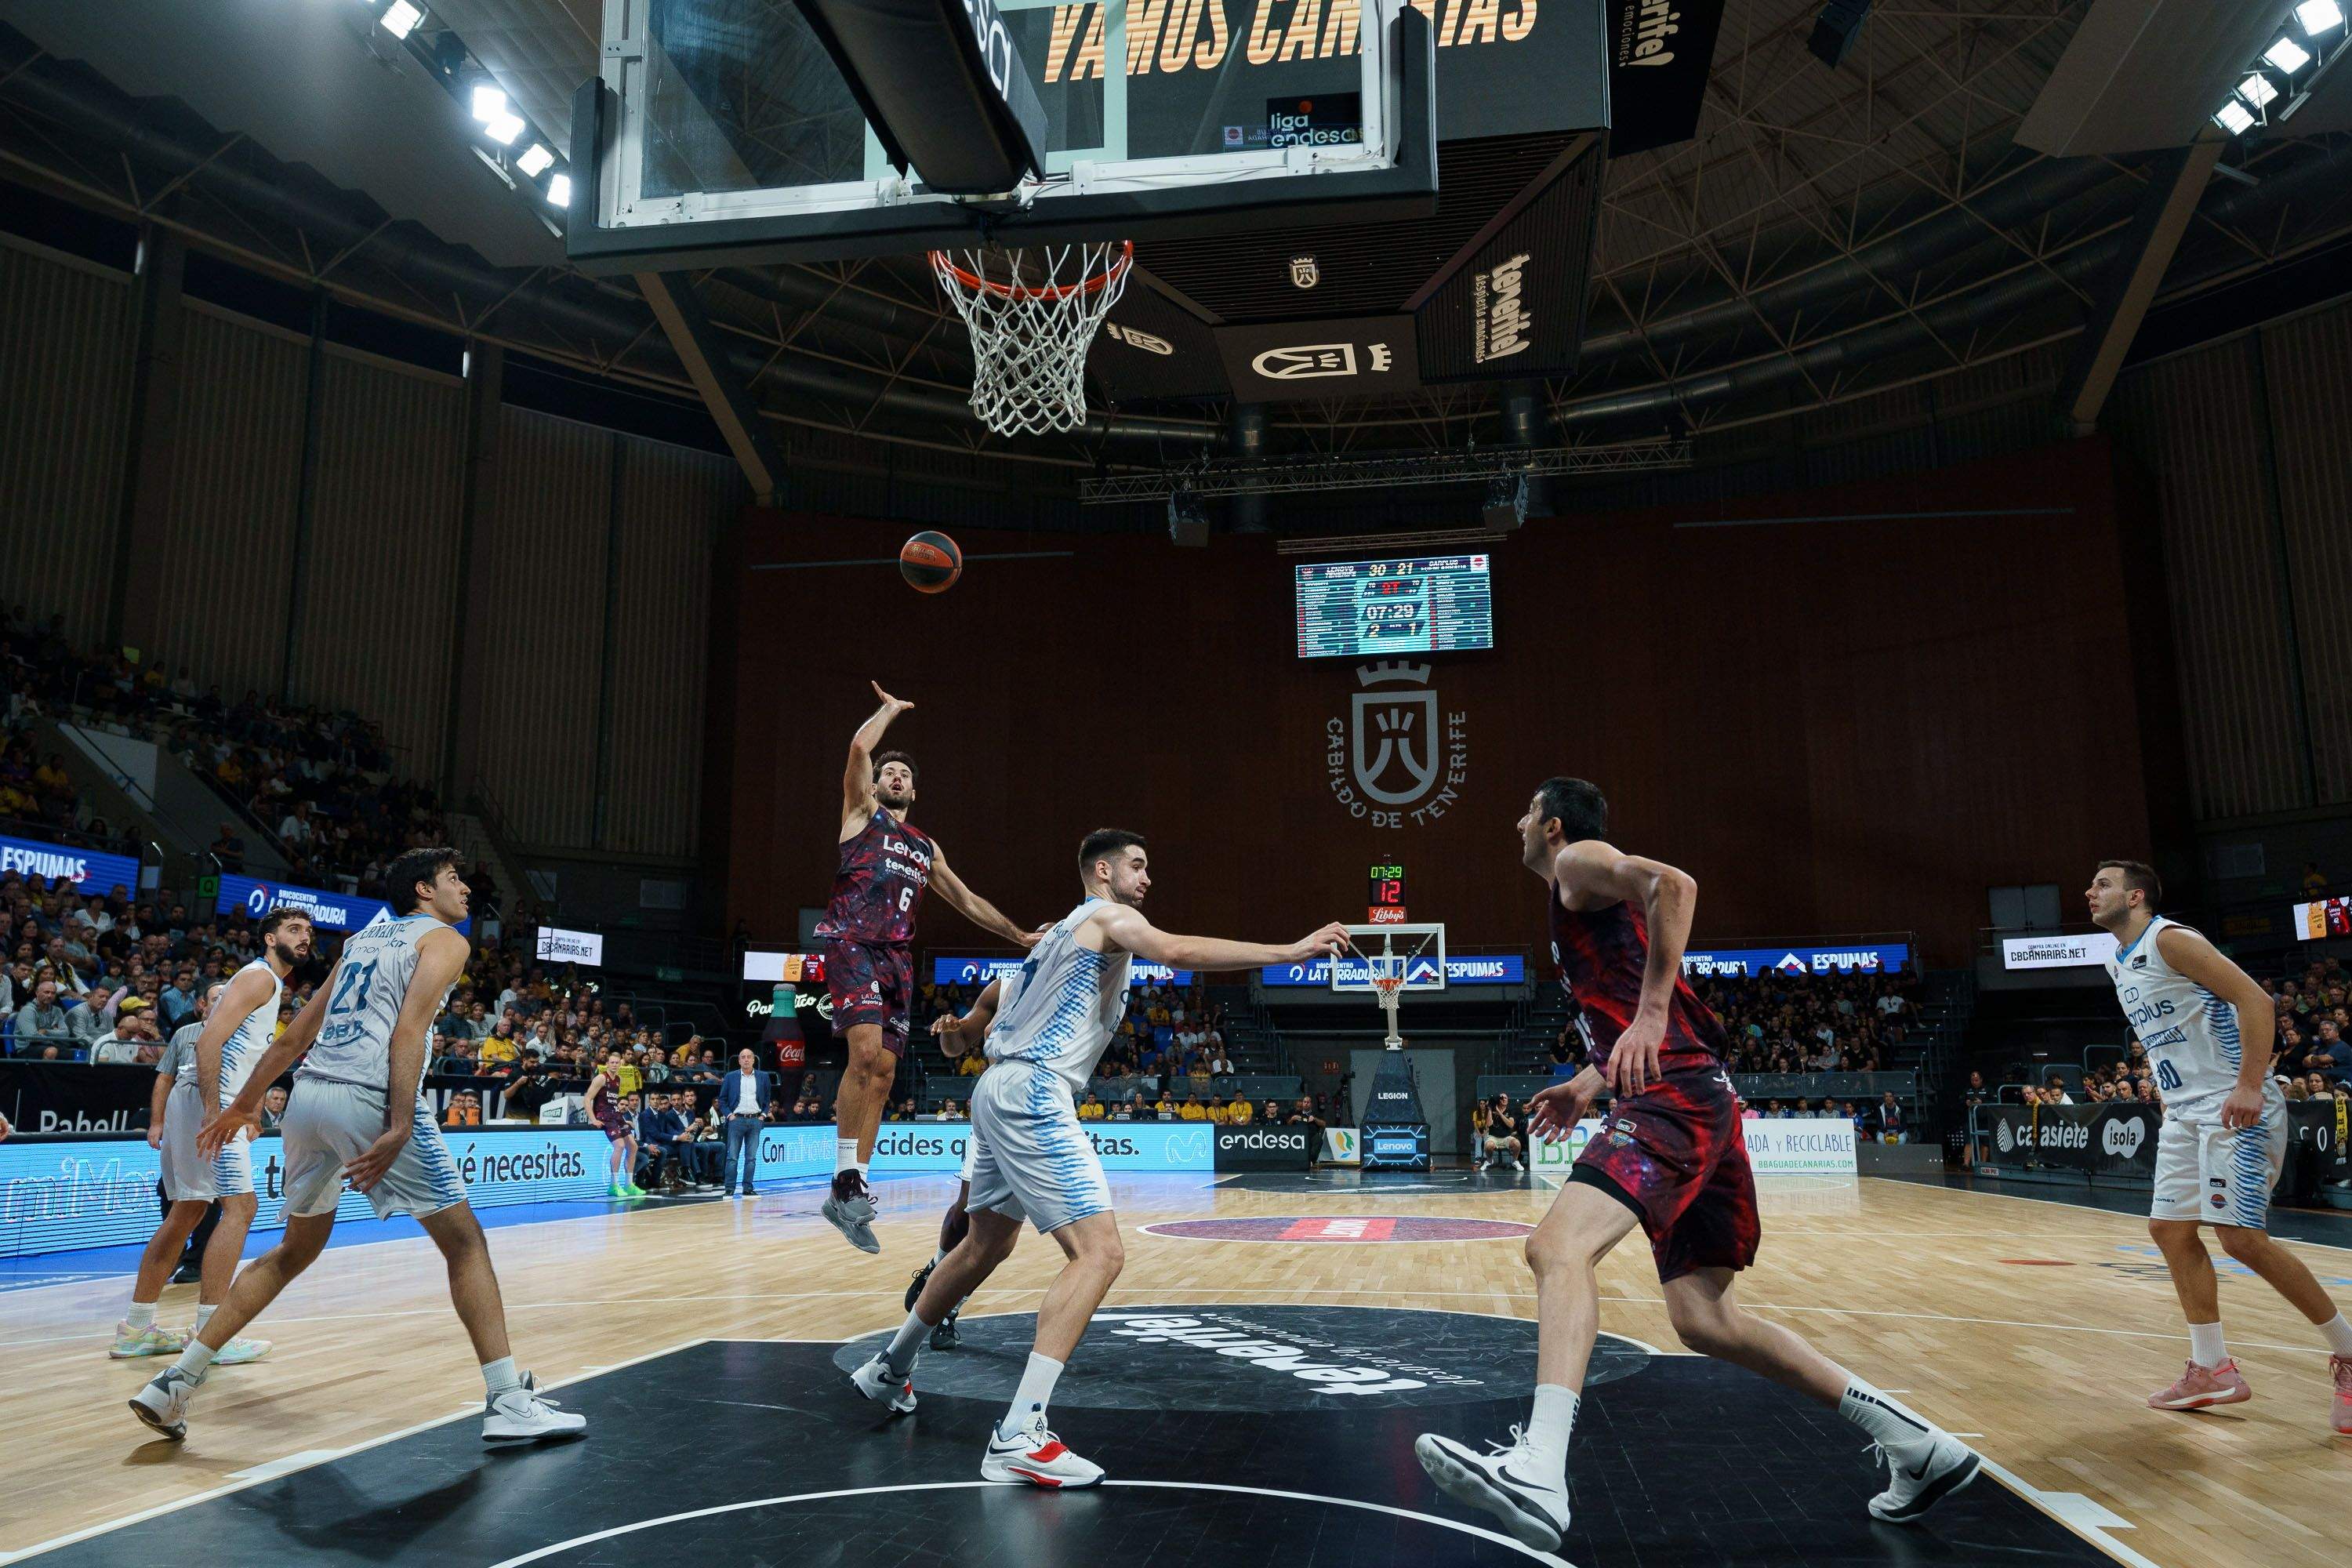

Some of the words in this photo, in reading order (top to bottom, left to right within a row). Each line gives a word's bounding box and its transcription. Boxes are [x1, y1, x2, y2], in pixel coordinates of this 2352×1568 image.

[1271, 113, 1308, 132] liga
[1368, 564, 1387, 577] 30
[1396, 562, 1414, 575] 21
[1366, 604, 1414, 620] 07:29
[1368, 623, 1380, 638] 2
[1327, 717, 1367, 818] CABILDO
[1372, 811, 1403, 829] DE
[1410, 711, 1467, 826] TENERIFE
[2, 846, 86, 884] ESPUMAS
[1370, 866, 1402, 878] 07:29
[278, 889, 318, 904] BRICOCENTRO
[898, 887, 914, 913] 6
[1380, 880, 1401, 903] 12
[1370, 907, 1404, 923] Libby's
[1813, 953, 1878, 971] ESPUMAS
[2011, 948, 2087, 962] CBCANARIAS.NET
[981, 969, 995, 981] LA
[1308, 969, 1321, 981] LA
[330, 958, 378, 1015] 21
[1220, 1130, 1305, 1150] endesa
[1748, 1134, 1769, 1153] ADA
[1786, 1134, 1853, 1152] RECICLABLE
[2016, 1120, 2089, 1149] caasiete
[2110, 1127, 2136, 1145] isola
[762, 1136, 785, 1163] Con
[1377, 1142, 1413, 1151] Lenovo
[482, 1142, 586, 1183] necesitas.
[1758, 1160, 1853, 1169] BBAGUADECANARIAS.COM
